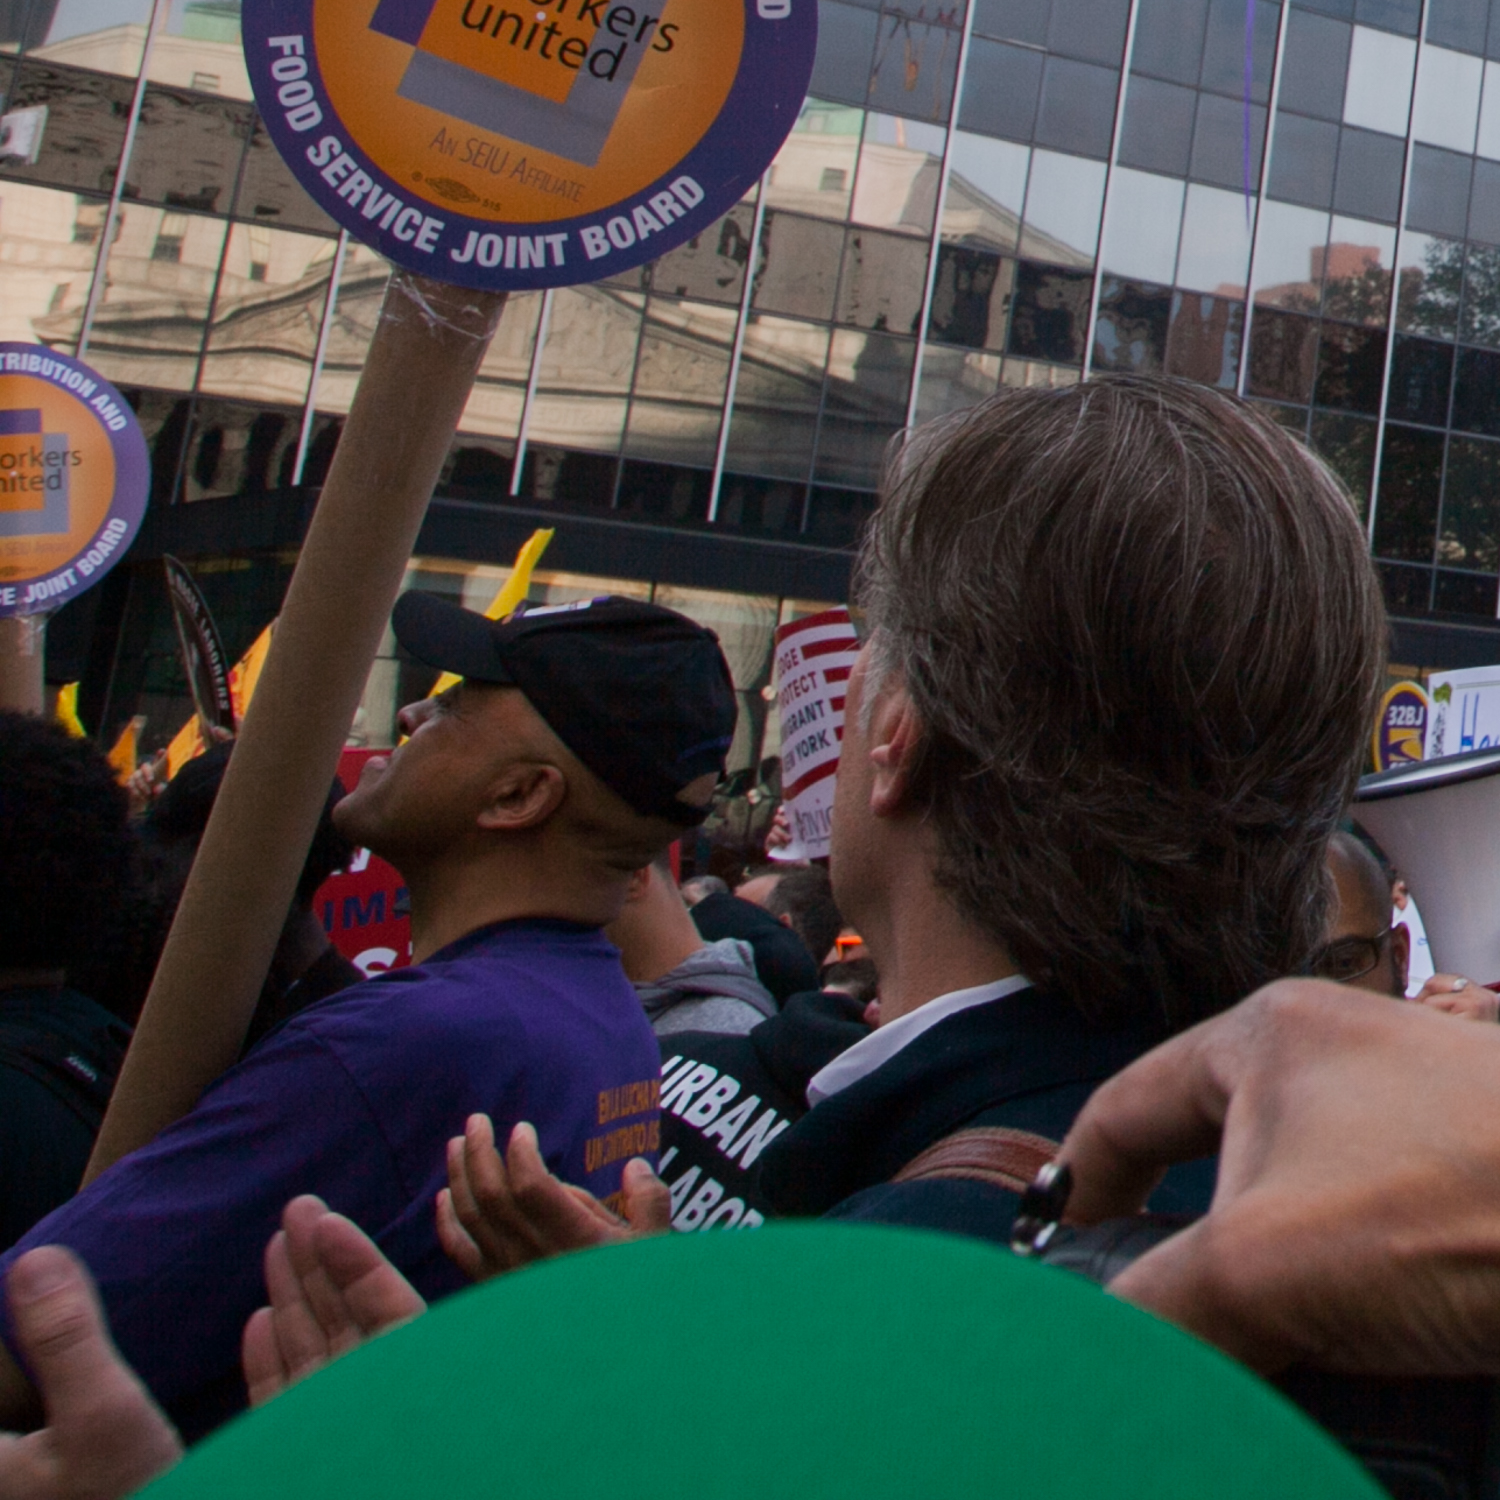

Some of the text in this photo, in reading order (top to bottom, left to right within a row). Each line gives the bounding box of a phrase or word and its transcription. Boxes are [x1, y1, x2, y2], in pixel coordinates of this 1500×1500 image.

[268, 34, 706, 270] FOOD SERVICE JOINT BOARD
[459, 137, 511, 176] SEIU
[90, 394, 128, 432] AND
[24, 568, 78, 604] JOINT
[76, 517, 129, 578] BOARD
[1386, 704, 1424, 726] 32BJ
[796, 728, 832, 761] YORK
